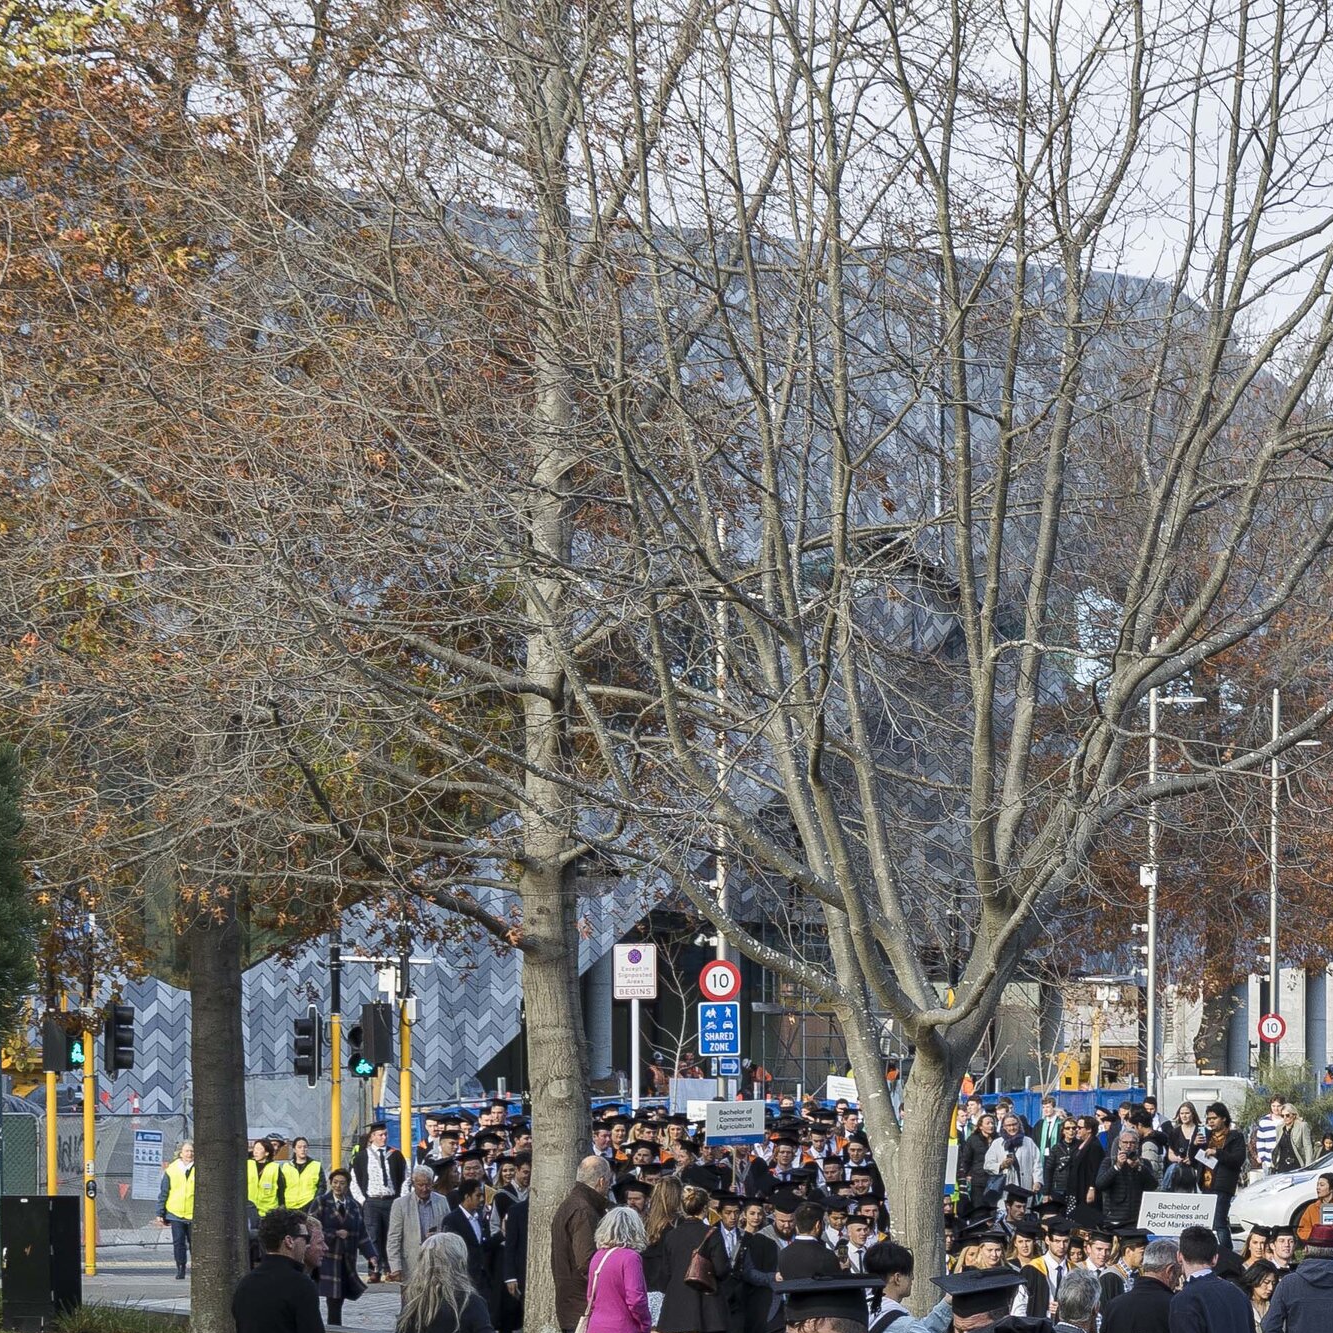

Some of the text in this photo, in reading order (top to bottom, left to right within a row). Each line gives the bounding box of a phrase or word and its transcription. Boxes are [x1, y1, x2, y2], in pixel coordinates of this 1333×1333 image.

[712, 973, 730, 989] 10
[1267, 1022, 1278, 1033] 10
[704, 1032, 735, 1041] SHARED
[709, 1042, 730, 1052] ZONE
[718, 1108, 745, 1116] Bachelor
[716, 1122, 754, 1131] (Agriculture)
[1158, 1203, 1200, 1211] Bachelor of
[1146, 1211, 1209, 1220] Agribusiness and
